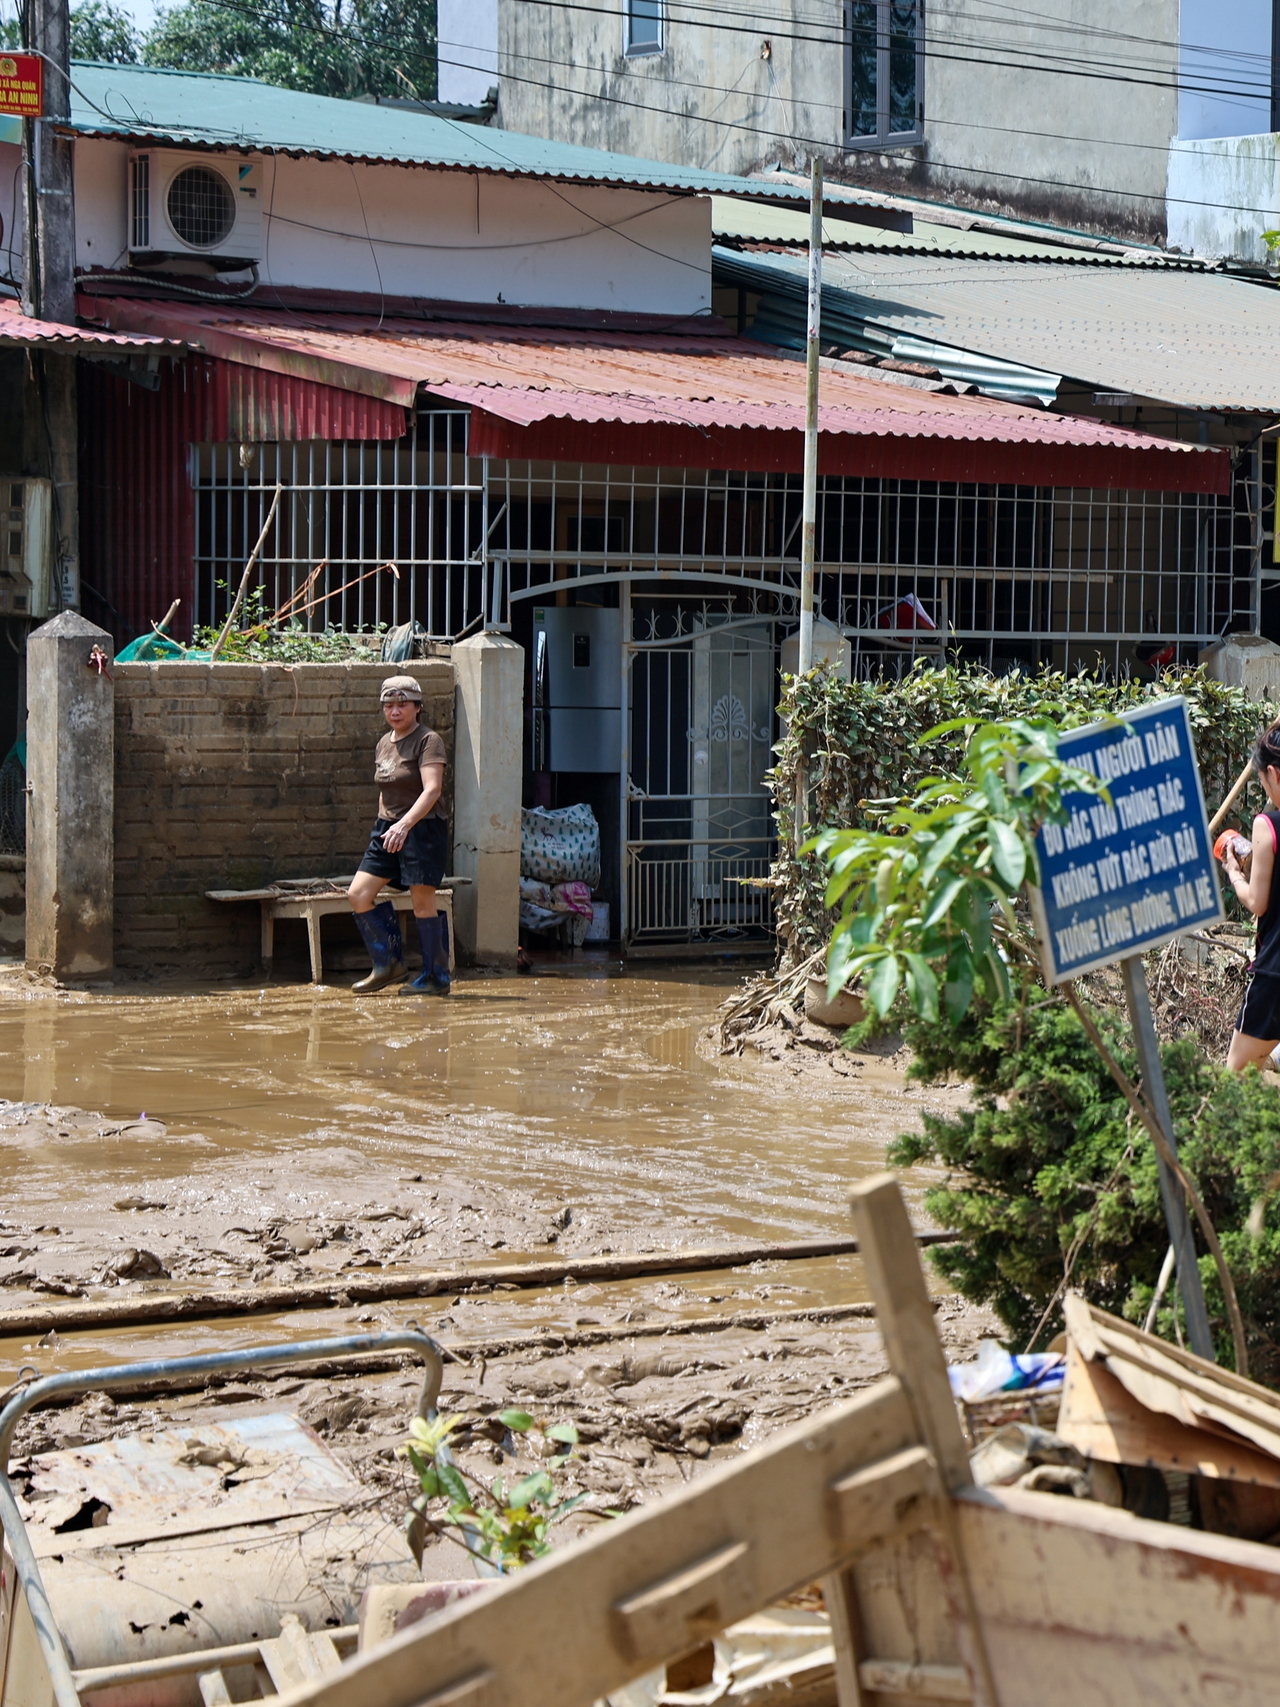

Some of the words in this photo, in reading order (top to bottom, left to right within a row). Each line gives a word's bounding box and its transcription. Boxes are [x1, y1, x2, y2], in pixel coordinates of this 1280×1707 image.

[1144, 721, 1181, 766] DÂN
[1064, 806, 1092, 850] RÁC
[1115, 785, 1160, 831] THÙNG
[1157, 773, 1186, 817] RÁC
[1051, 861, 1100, 910] KHÔNG
[1121, 839, 1151, 884] RÁC
[1173, 822, 1199, 865] BÃI
[1055, 911, 1101, 965] XUỐNG
[1098, 903, 1134, 949] LÒNG
